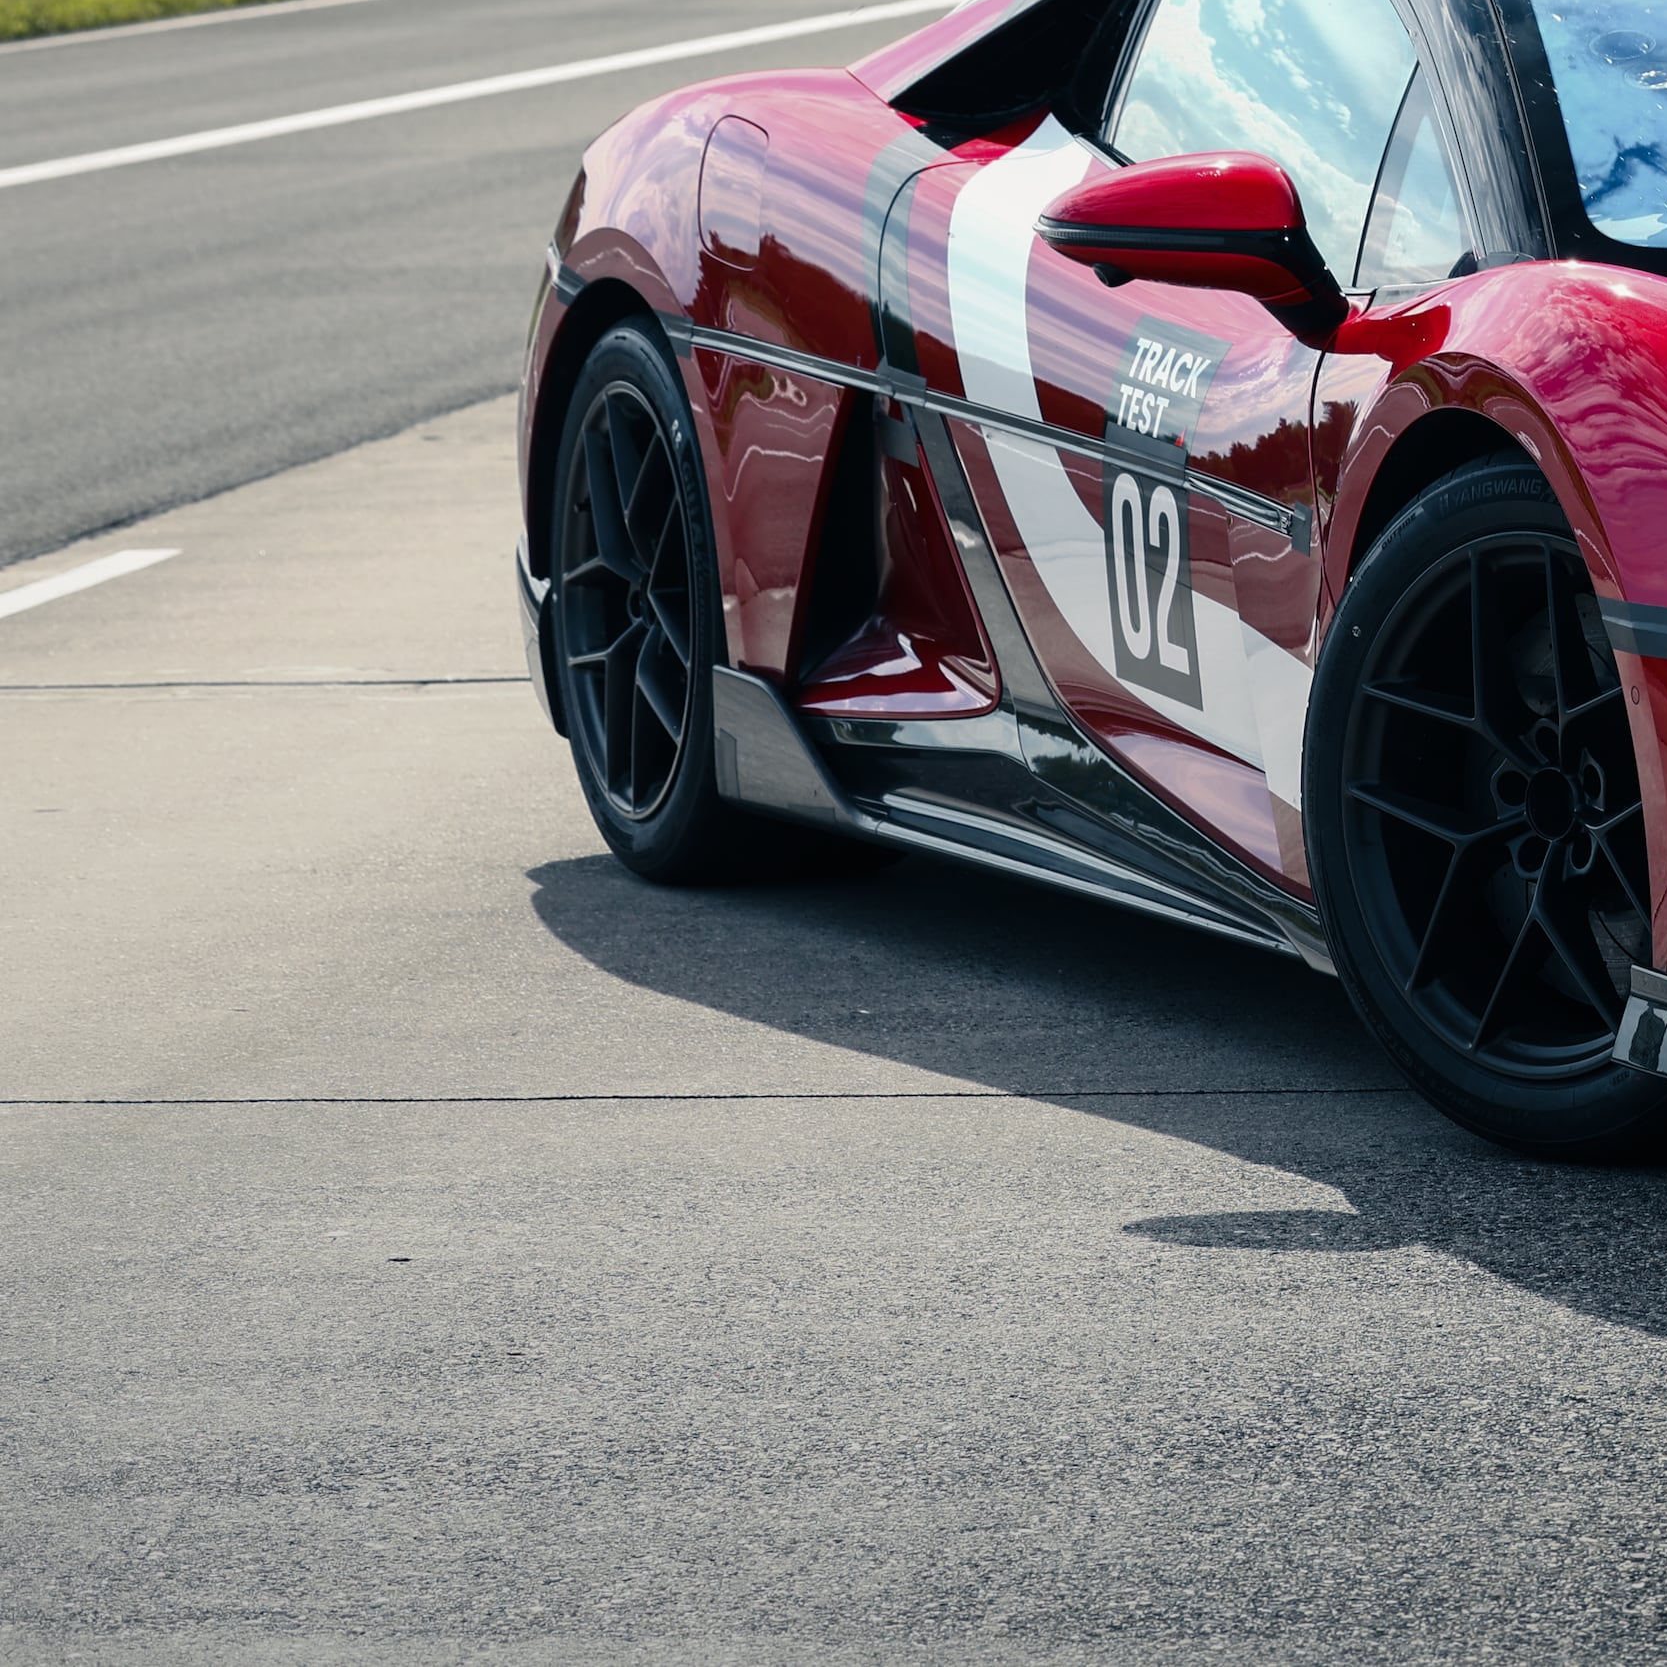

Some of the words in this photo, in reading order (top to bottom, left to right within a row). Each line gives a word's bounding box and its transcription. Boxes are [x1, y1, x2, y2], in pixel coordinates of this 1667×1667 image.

[1128, 337, 1212, 399] TRACK
[1117, 383, 1170, 439] TEST
[1454, 477, 1542, 507] YANGWANG
[1112, 473, 1191, 672] 02
